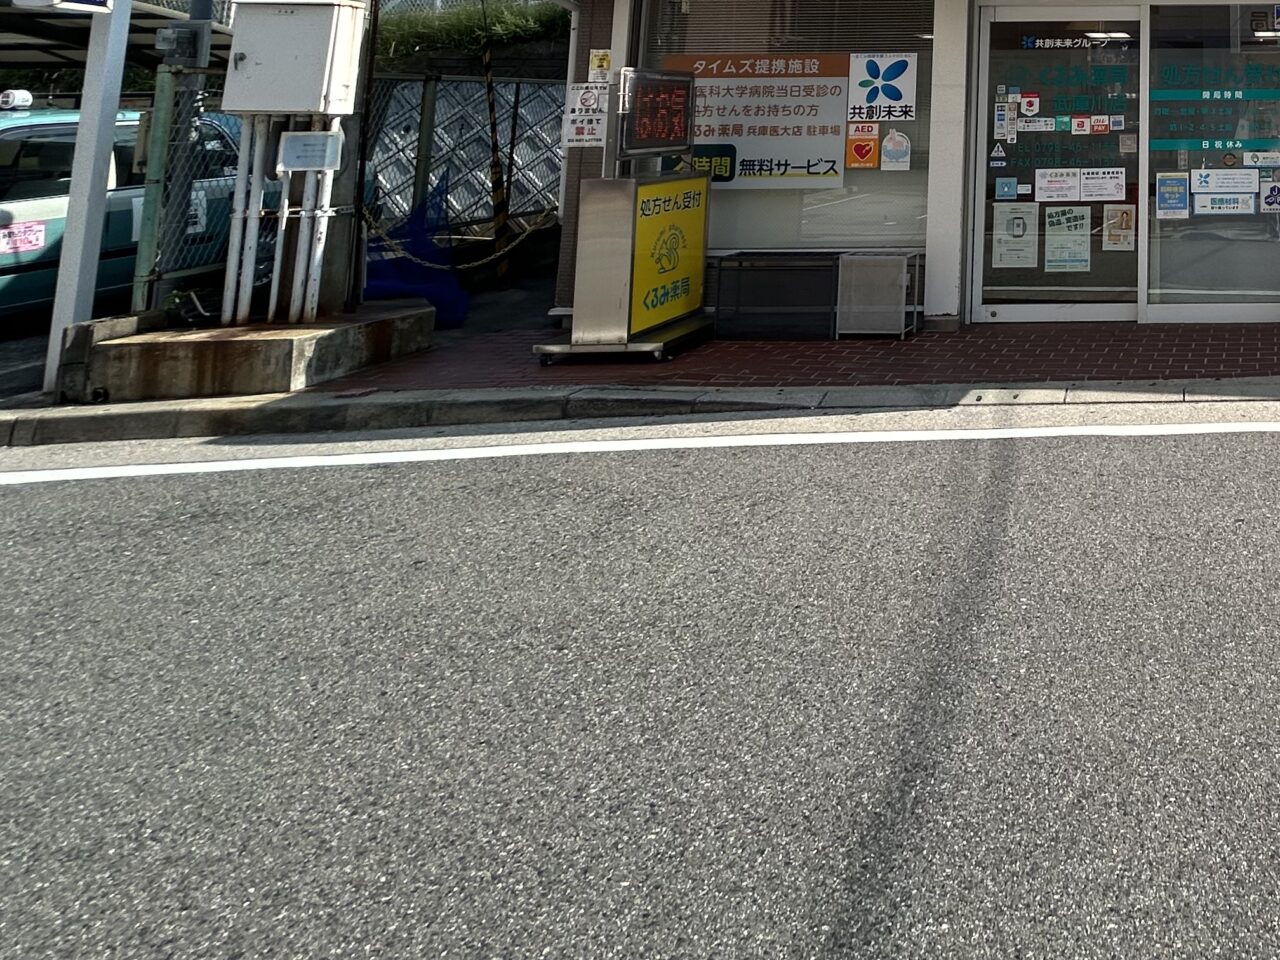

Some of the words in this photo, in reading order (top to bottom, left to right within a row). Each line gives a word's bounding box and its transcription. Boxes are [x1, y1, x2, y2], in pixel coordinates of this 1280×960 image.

[1034, 38, 1111, 49] 共創未来グループ
[693, 58, 820, 74] タイムズ提携施設
[695, 85, 841, 98] 医科大学病院当日受診の
[849, 104, 914, 120] 共創未来
[694, 124, 744, 137] るみ薬局
[747, 126, 803, 137] 兵庫医大店
[806, 125, 841, 136] 駐車場
[854, 125, 874, 133] AED
[738, 157, 839, 176] 無料サービス
[640, 190, 702, 218] 処方せん受付
[642, 276, 691, 311] くるみ薬局
